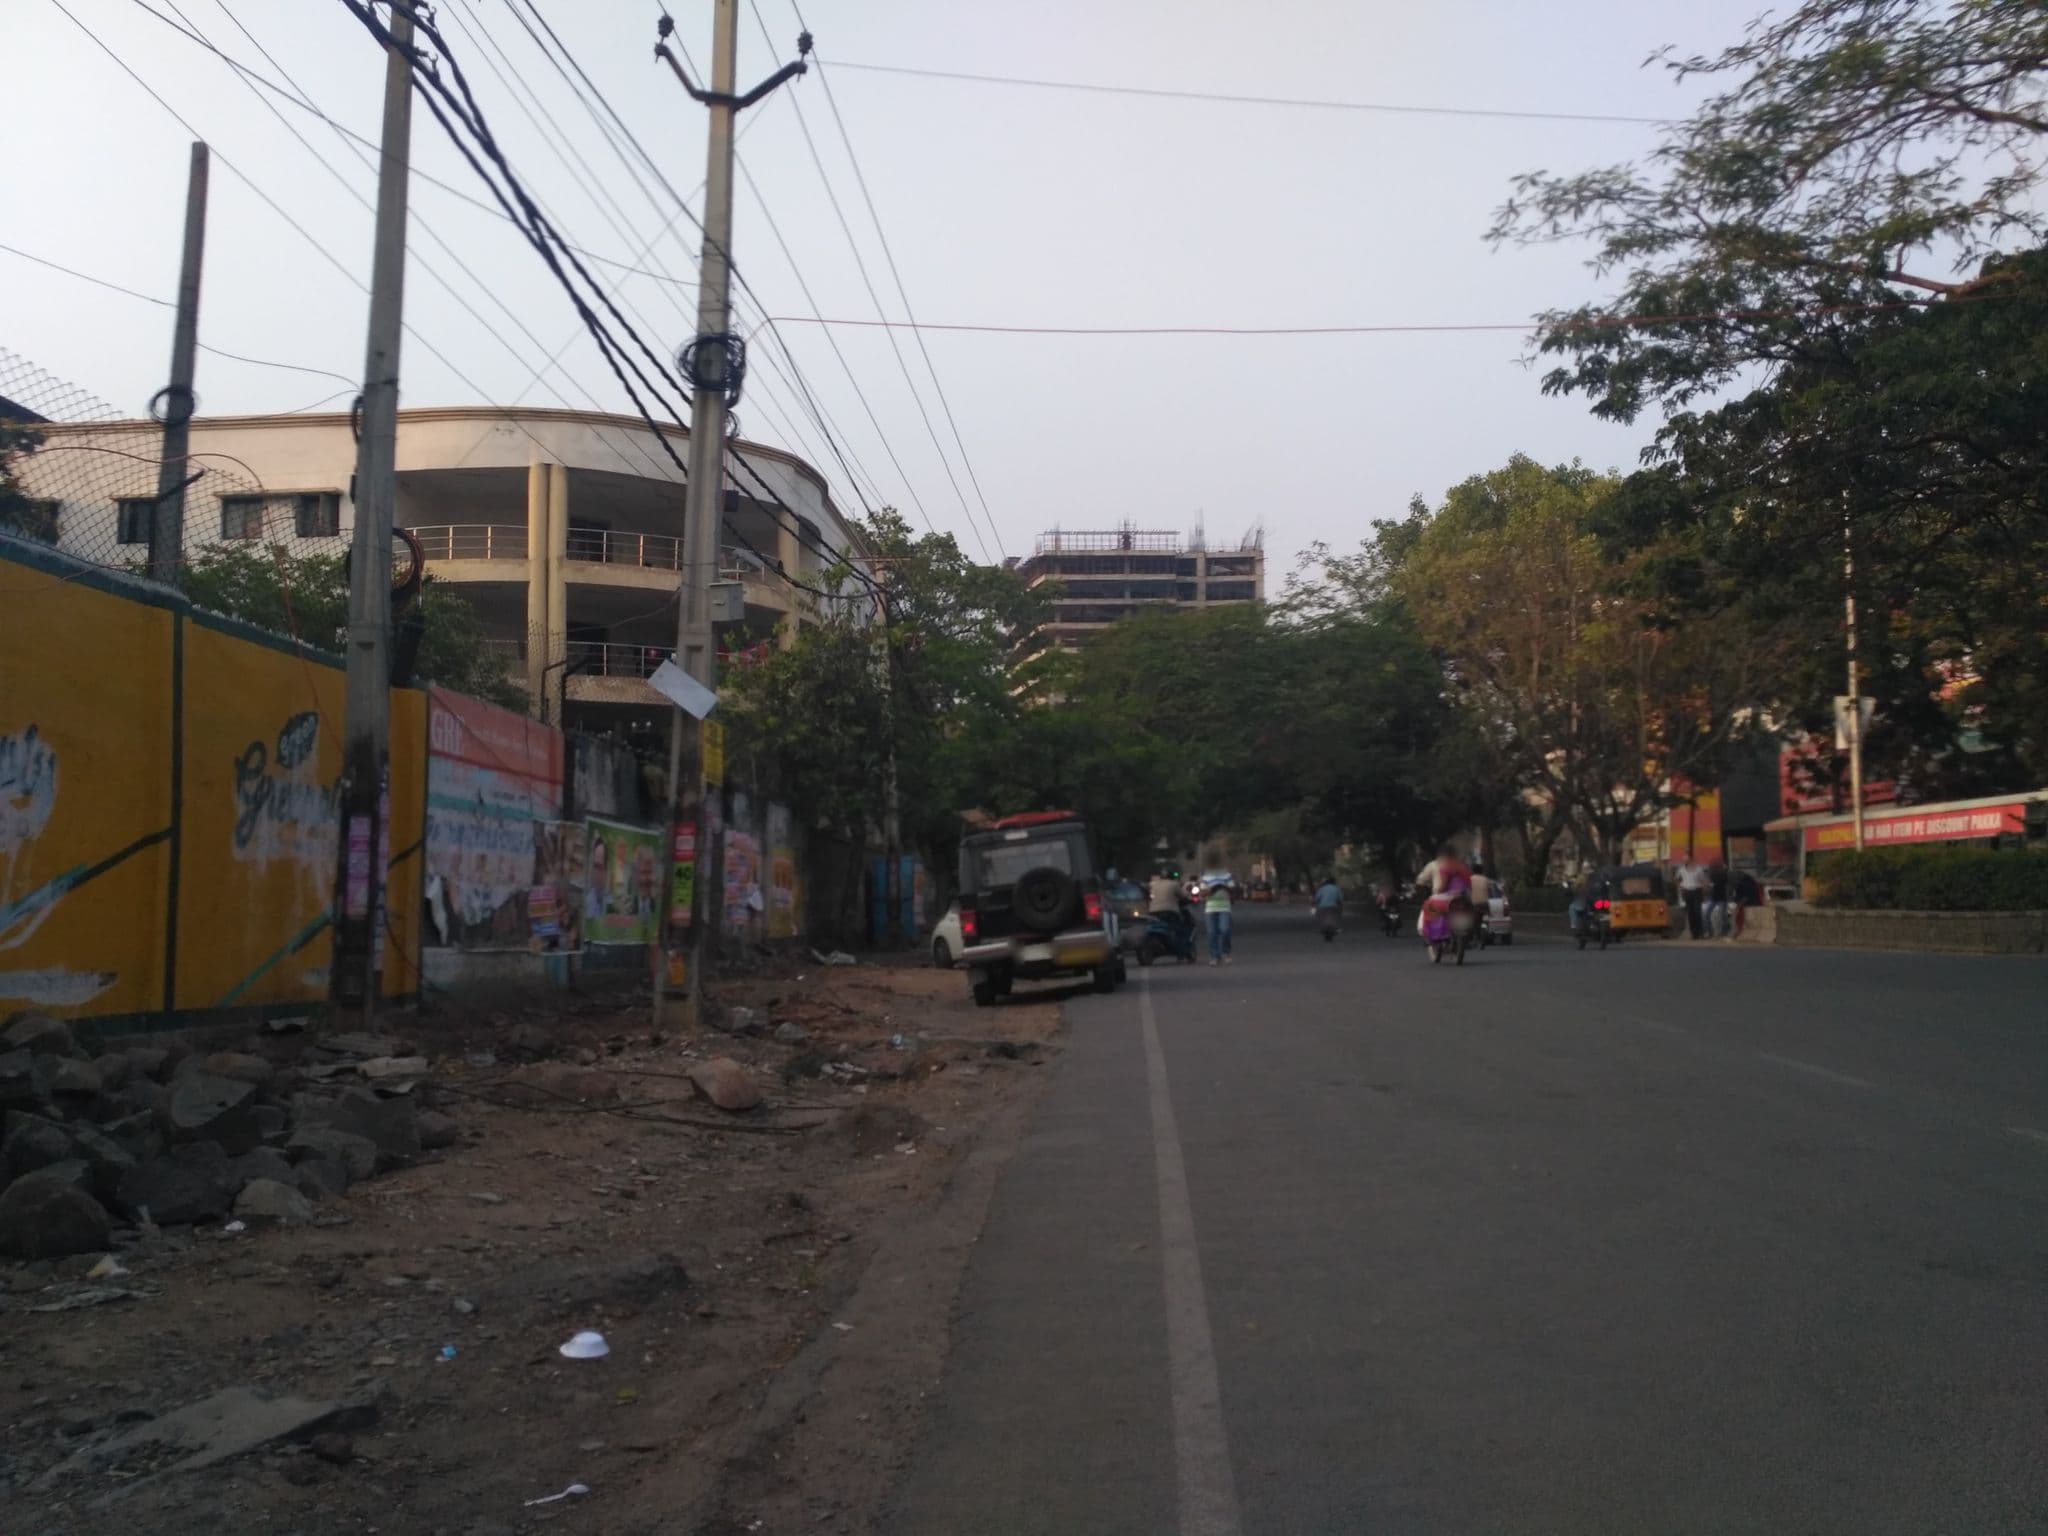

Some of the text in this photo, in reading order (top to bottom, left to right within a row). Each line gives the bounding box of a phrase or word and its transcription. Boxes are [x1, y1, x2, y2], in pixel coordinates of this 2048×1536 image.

[1913, 820, 1925, 836] PE
[1927, 815, 1969, 835] DISCOUNT
[1971, 812, 2001, 830] PAKKA
